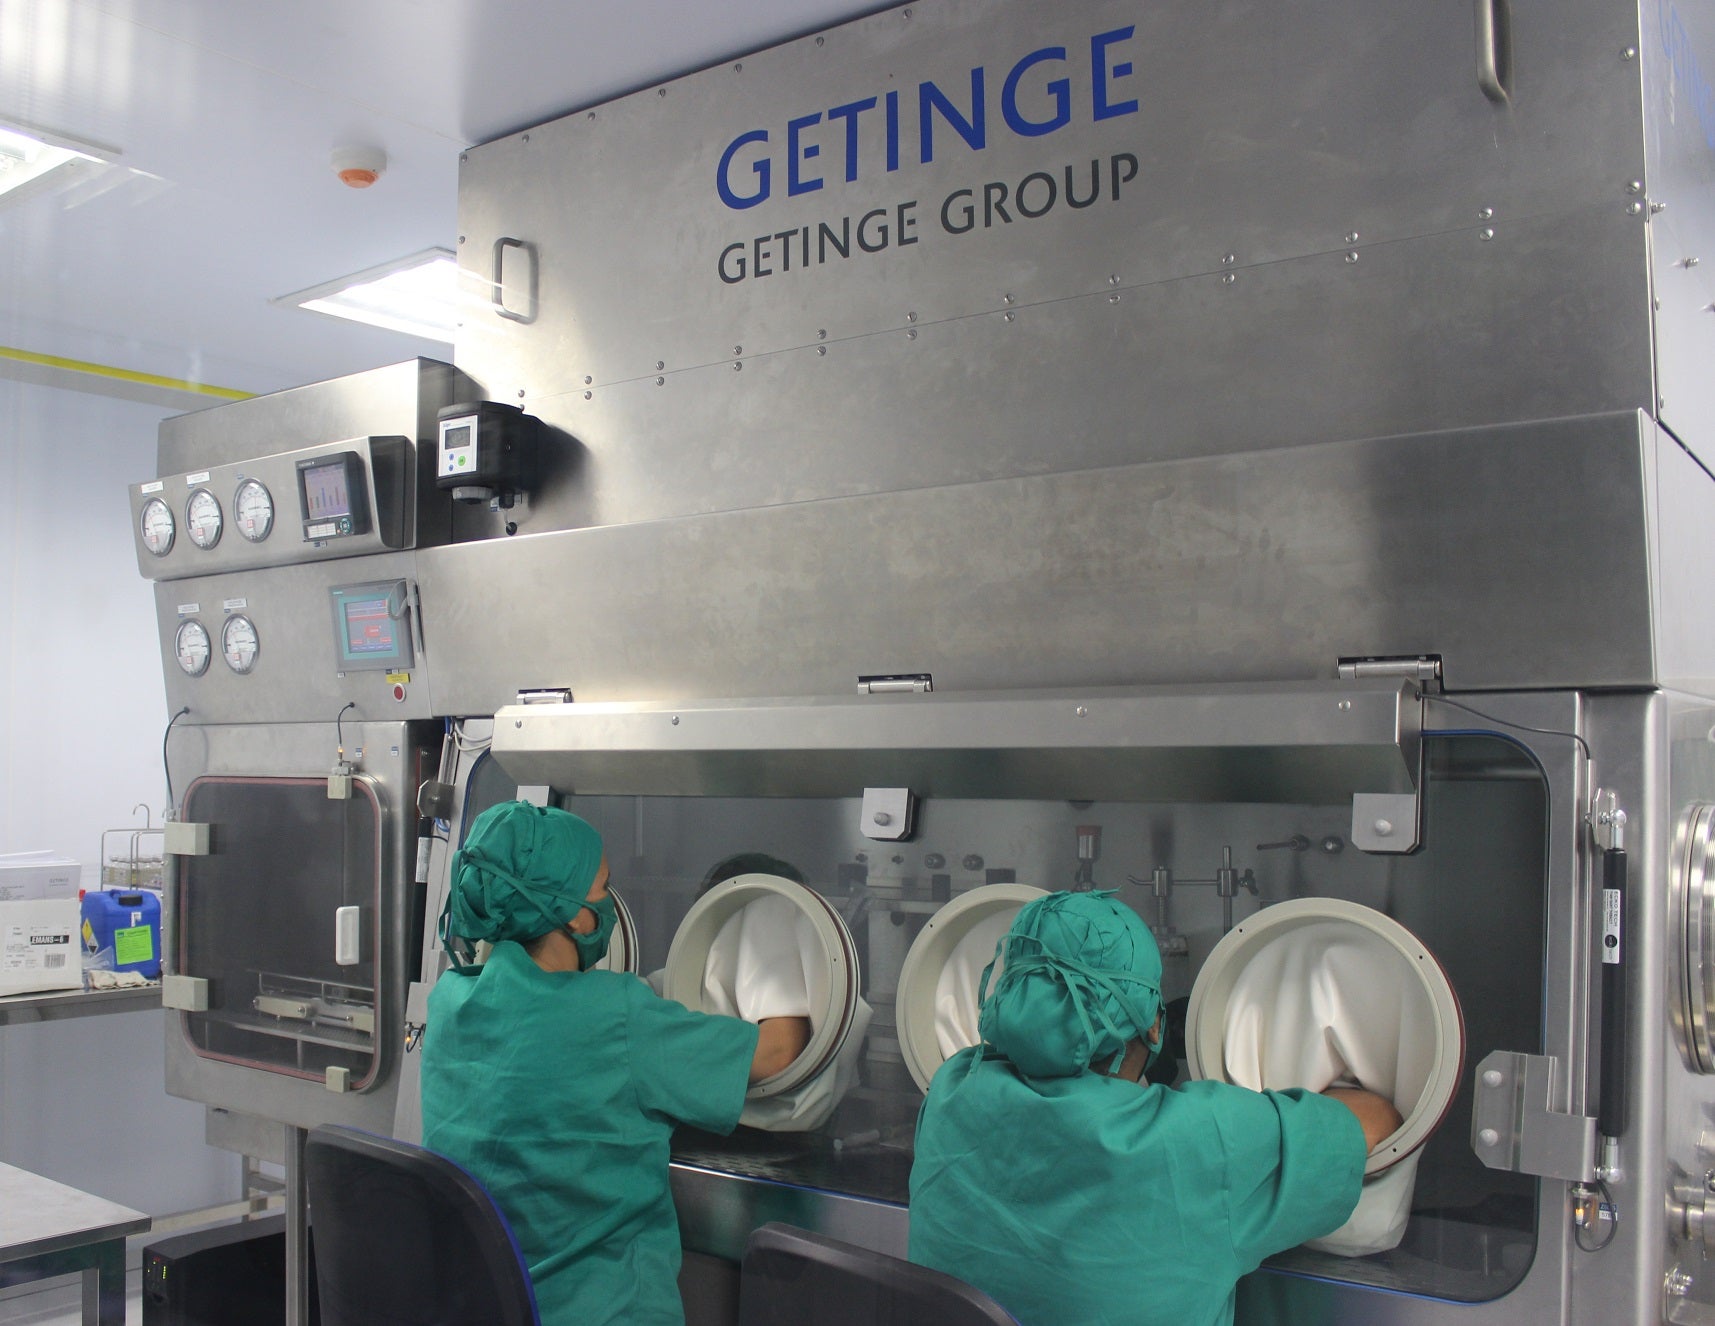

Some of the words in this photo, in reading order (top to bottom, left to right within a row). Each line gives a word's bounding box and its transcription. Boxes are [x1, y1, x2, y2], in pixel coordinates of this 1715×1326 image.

[716, 25, 1139, 210] GETINGE
[718, 201, 918, 284] GETINGE
[940, 152, 1139, 234] GROUP
